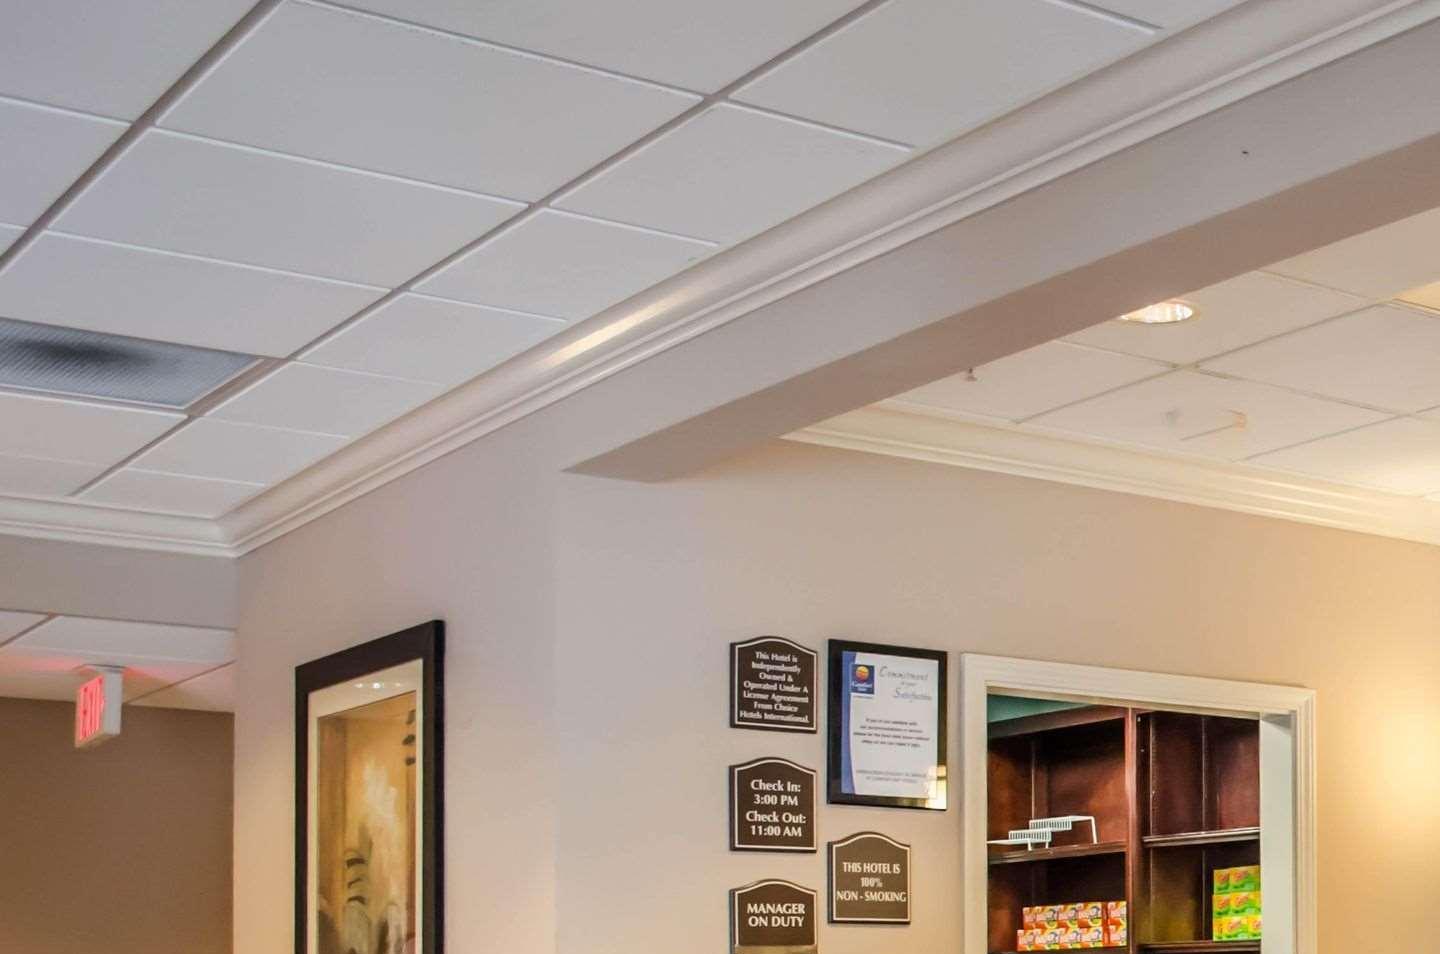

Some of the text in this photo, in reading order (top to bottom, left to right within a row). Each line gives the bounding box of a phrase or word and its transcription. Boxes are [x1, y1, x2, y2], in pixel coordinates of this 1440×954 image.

[750, 779, 801, 792] Check In:
[753, 794, 798, 806] 3:00 PM
[746, 810, 807, 824] Check Out:
[750, 825, 802, 837] 11:00 AM
[842, 862, 901, 874] THIS HOTEL IS
[860, 877, 883, 888] 100%
[836, 891, 859, 901] NON
[864, 891, 907, 903] SMOKING
[746, 903, 805, 914] MANAGER
[748, 916, 805, 928] ON DUTY
